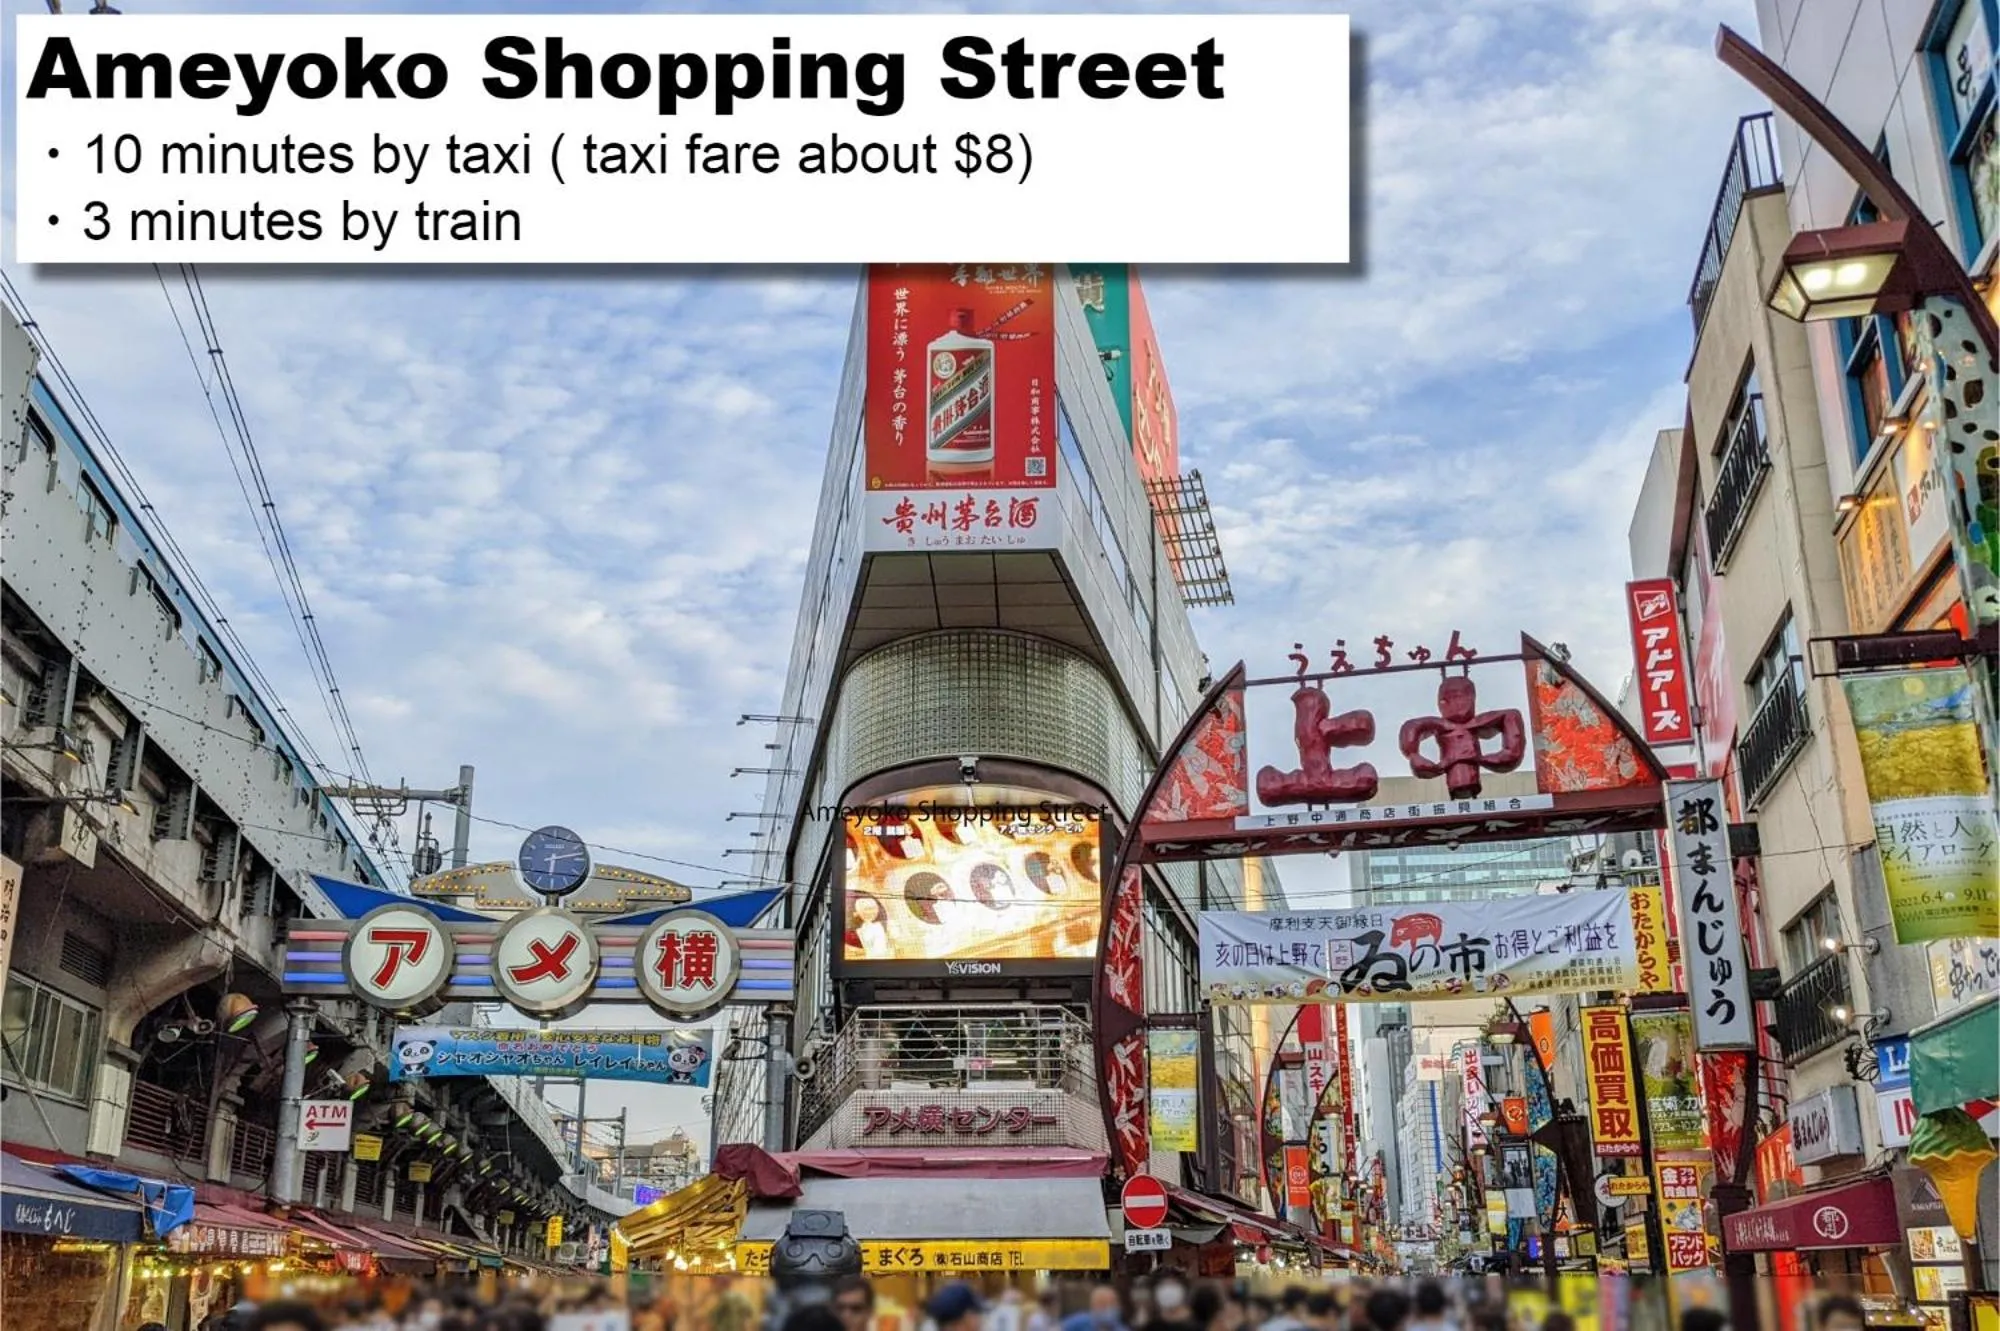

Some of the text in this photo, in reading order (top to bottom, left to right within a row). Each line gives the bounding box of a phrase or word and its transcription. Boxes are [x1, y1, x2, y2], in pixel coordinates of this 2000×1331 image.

[893, 287, 911, 361] 世界に漂う
[1288, 629, 1478, 676] うえちゅん
[1641, 626, 1681, 732] アドアーズ
[1256, 676, 1526, 808] 上中
[1263, 798, 1523, 828] 上野中通商店街振興組合
[1676, 797, 1736, 1025] 都まんじゅう
[368, 928, 718, 991] アメ横
[1215, 942, 1326, 968] 亥の日は上野で
[1494, 921, 1619, 960] お得とご利益を
[1630, 892, 1660, 990] おたからや
[436, 1050, 566, 1067] シャオシャオちゃん
[1586, 1009, 1634, 1139] 高価買取
[306, 1105, 347, 1118] ATM
[863, 1104, 1057, 1134] アメ横センター
[879, 1247, 924, 1267] まぐろ
[1010, 1251, 1025, 1266] TEL
[1669, 1235, 1705, 1250] ブランド
[1671, 1250, 1705, 1267] バッグ
